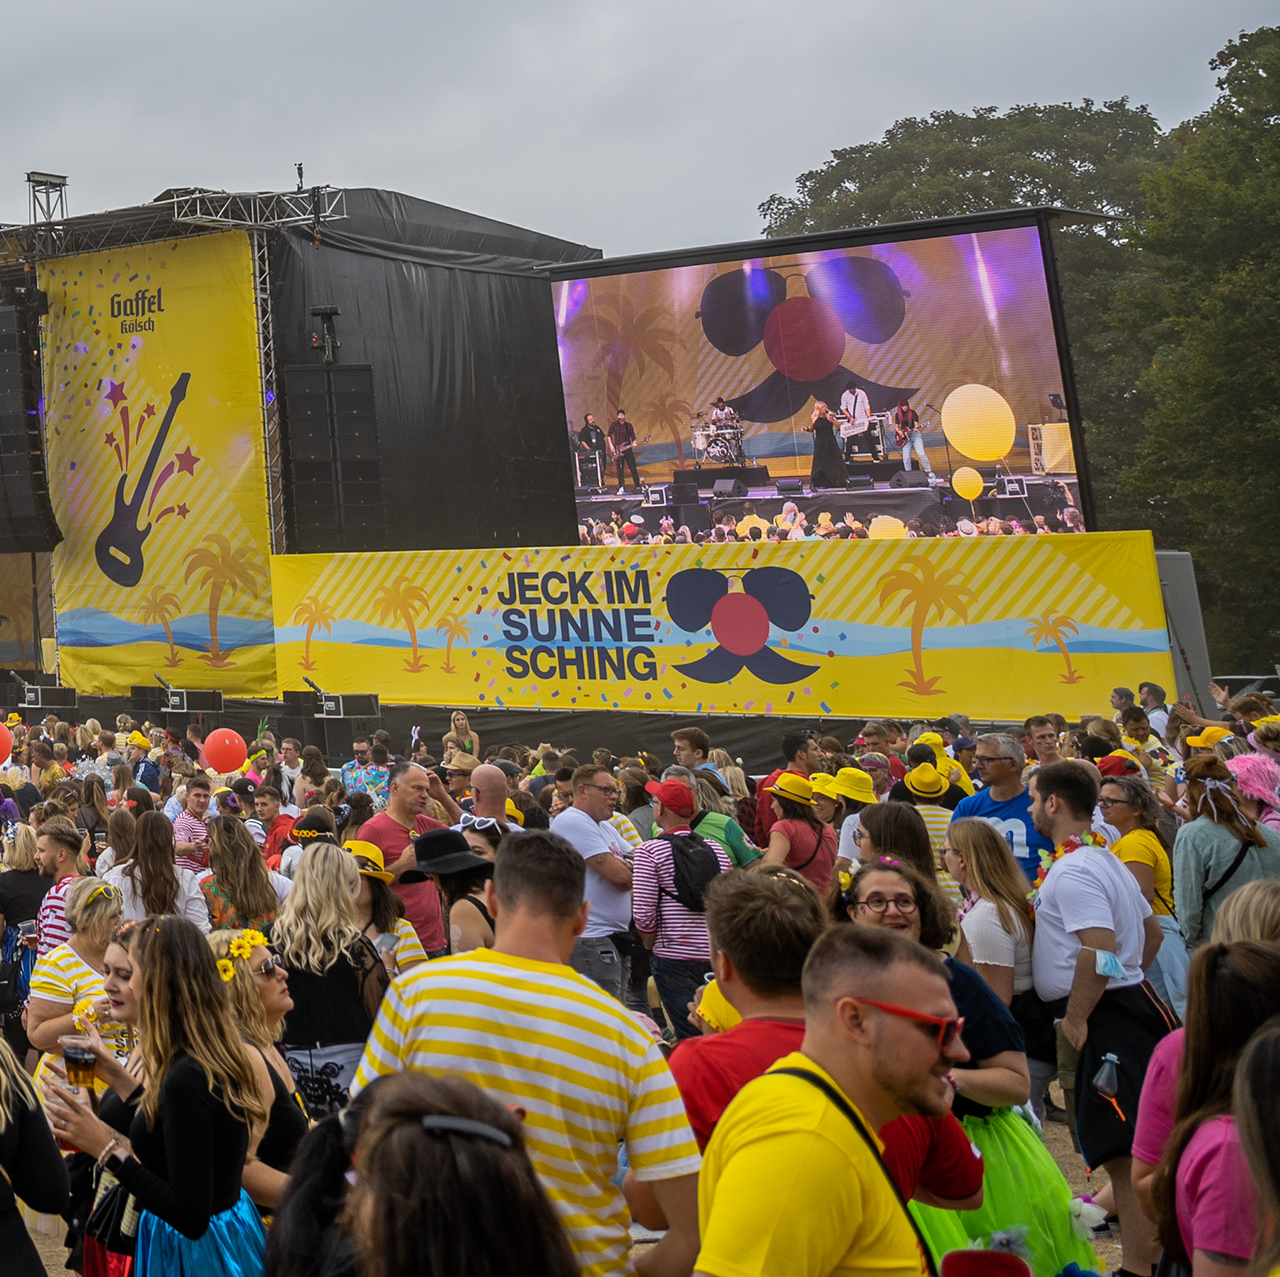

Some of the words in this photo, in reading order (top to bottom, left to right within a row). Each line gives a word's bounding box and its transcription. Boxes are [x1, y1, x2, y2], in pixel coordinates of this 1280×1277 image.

[110, 287, 165, 318] Gaffel
[120, 317, 155, 334] Kölsch
[497, 570, 599, 606] JECK
[603, 569, 652, 605] IM
[502, 607, 655, 643] SUNNE
[505, 644, 658, 682] SCHING
